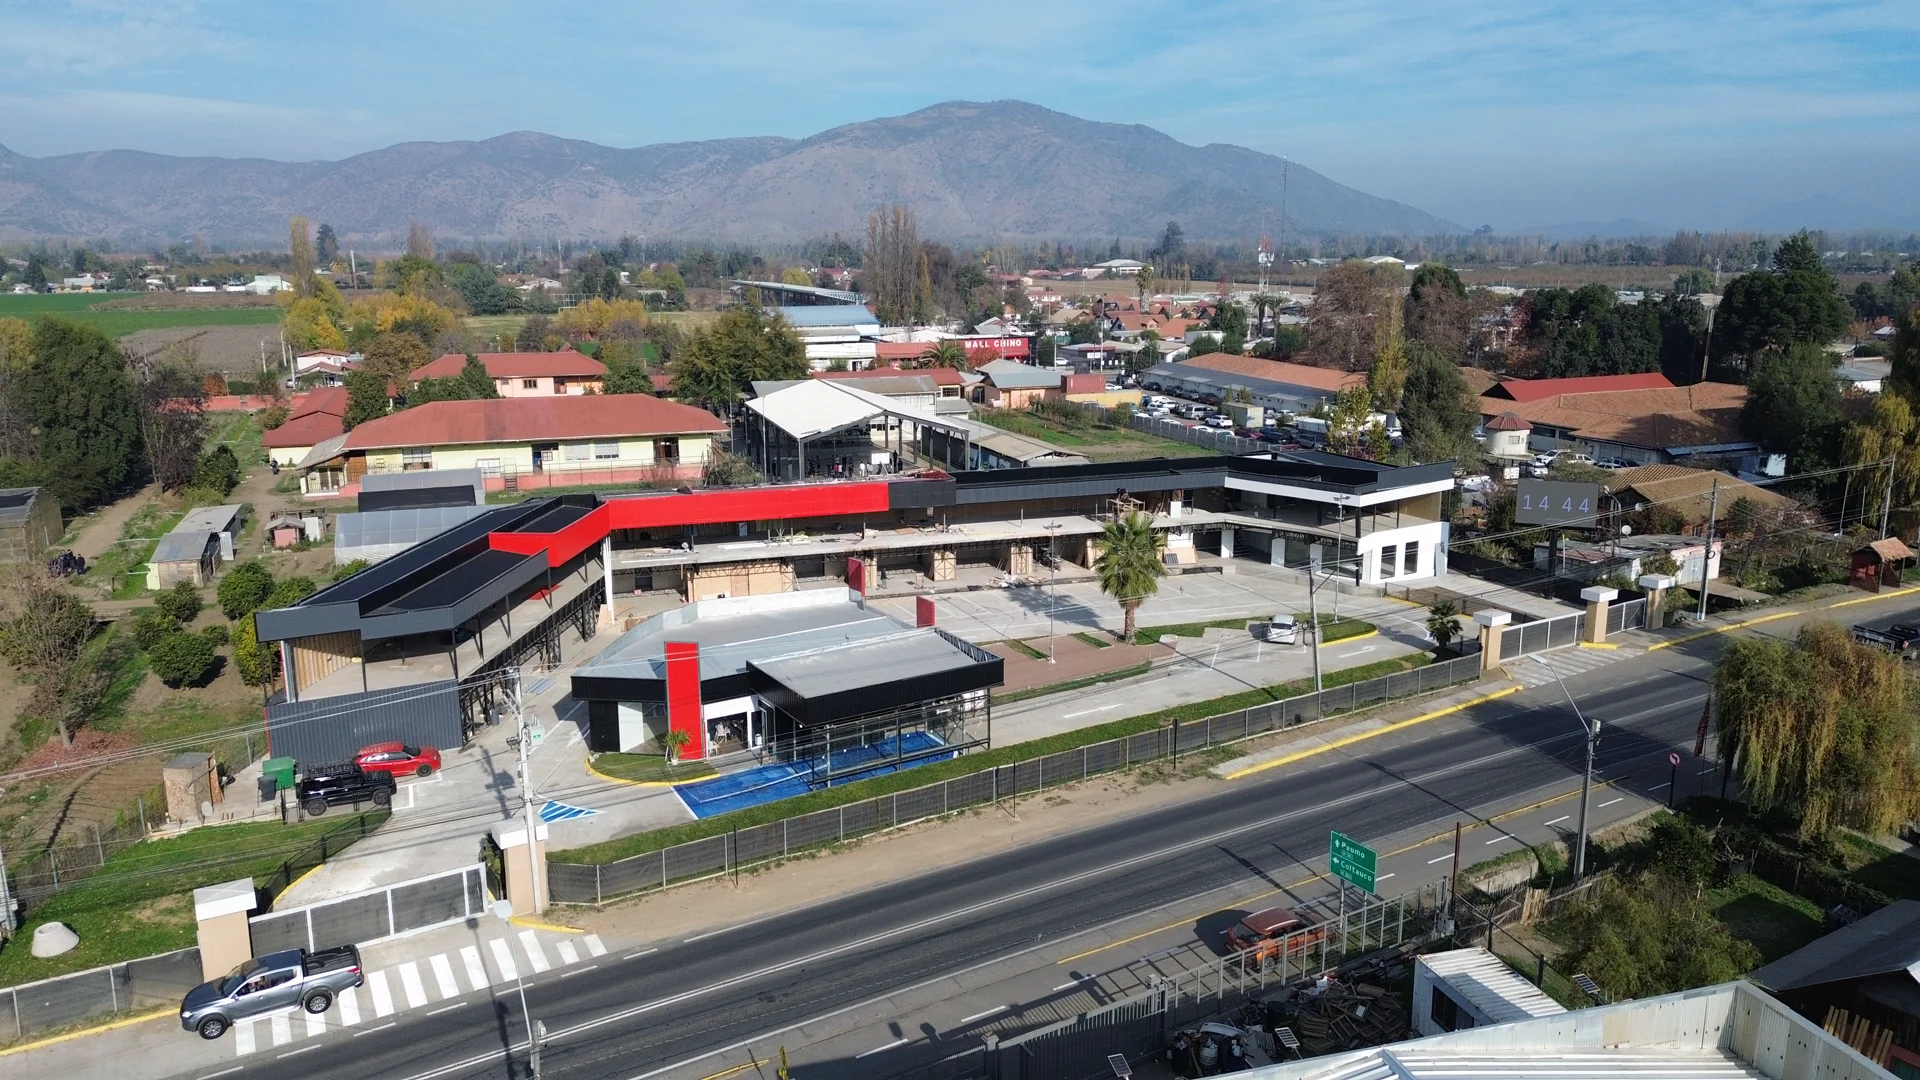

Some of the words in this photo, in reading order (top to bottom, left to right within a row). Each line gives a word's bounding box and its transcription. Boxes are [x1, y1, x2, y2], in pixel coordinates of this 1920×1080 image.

[993, 339, 1022, 347] CHINO
[1341, 841, 1366, 859] Peumo
[1340, 861, 1372, 882] Coltauco
